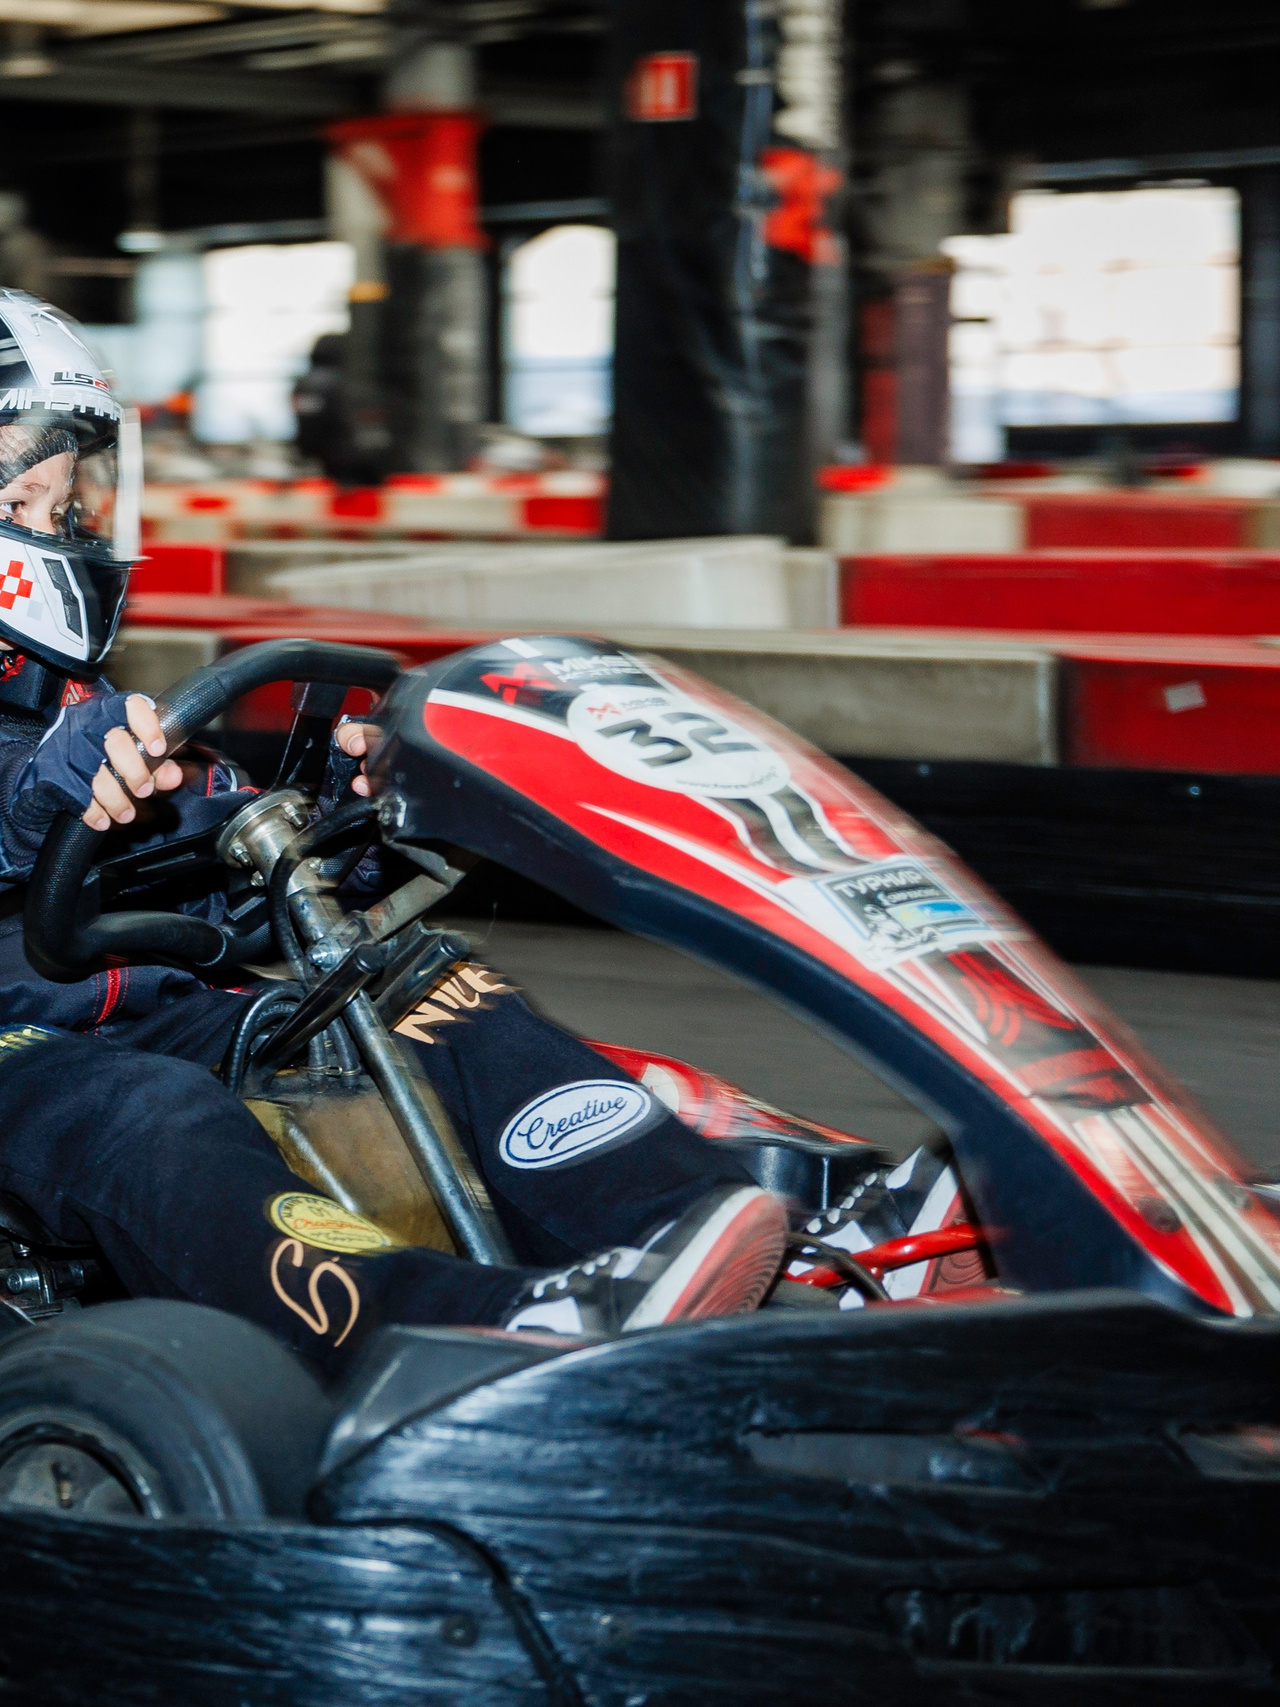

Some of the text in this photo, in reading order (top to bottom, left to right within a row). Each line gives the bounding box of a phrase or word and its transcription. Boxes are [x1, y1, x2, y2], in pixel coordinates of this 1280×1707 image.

[52, 370, 109, 392] LS2
[595, 712, 760, 769] 32
[517, 1095, 628, 1151] Creative
